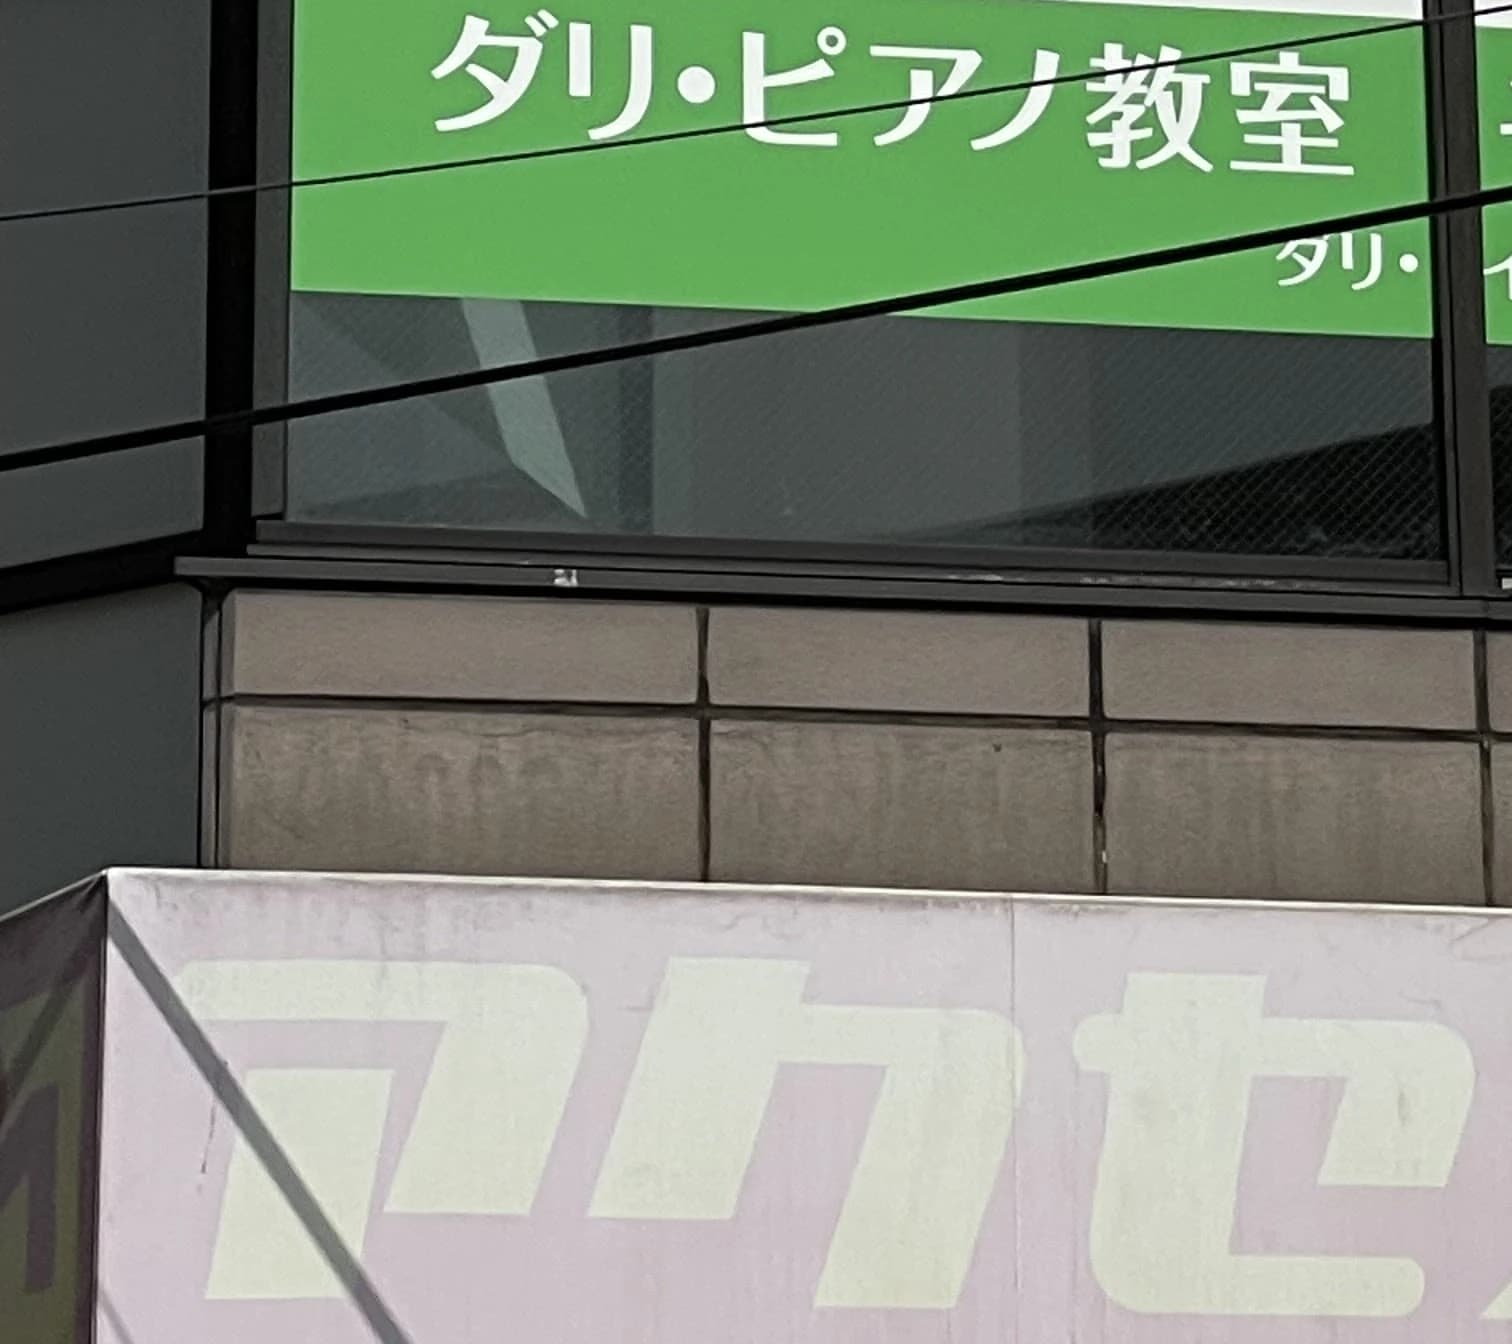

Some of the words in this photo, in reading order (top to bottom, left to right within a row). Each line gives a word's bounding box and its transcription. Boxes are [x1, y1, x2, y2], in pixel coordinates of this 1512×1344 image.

[431, 9, 1355, 176] ダリ・ピアノ教室
